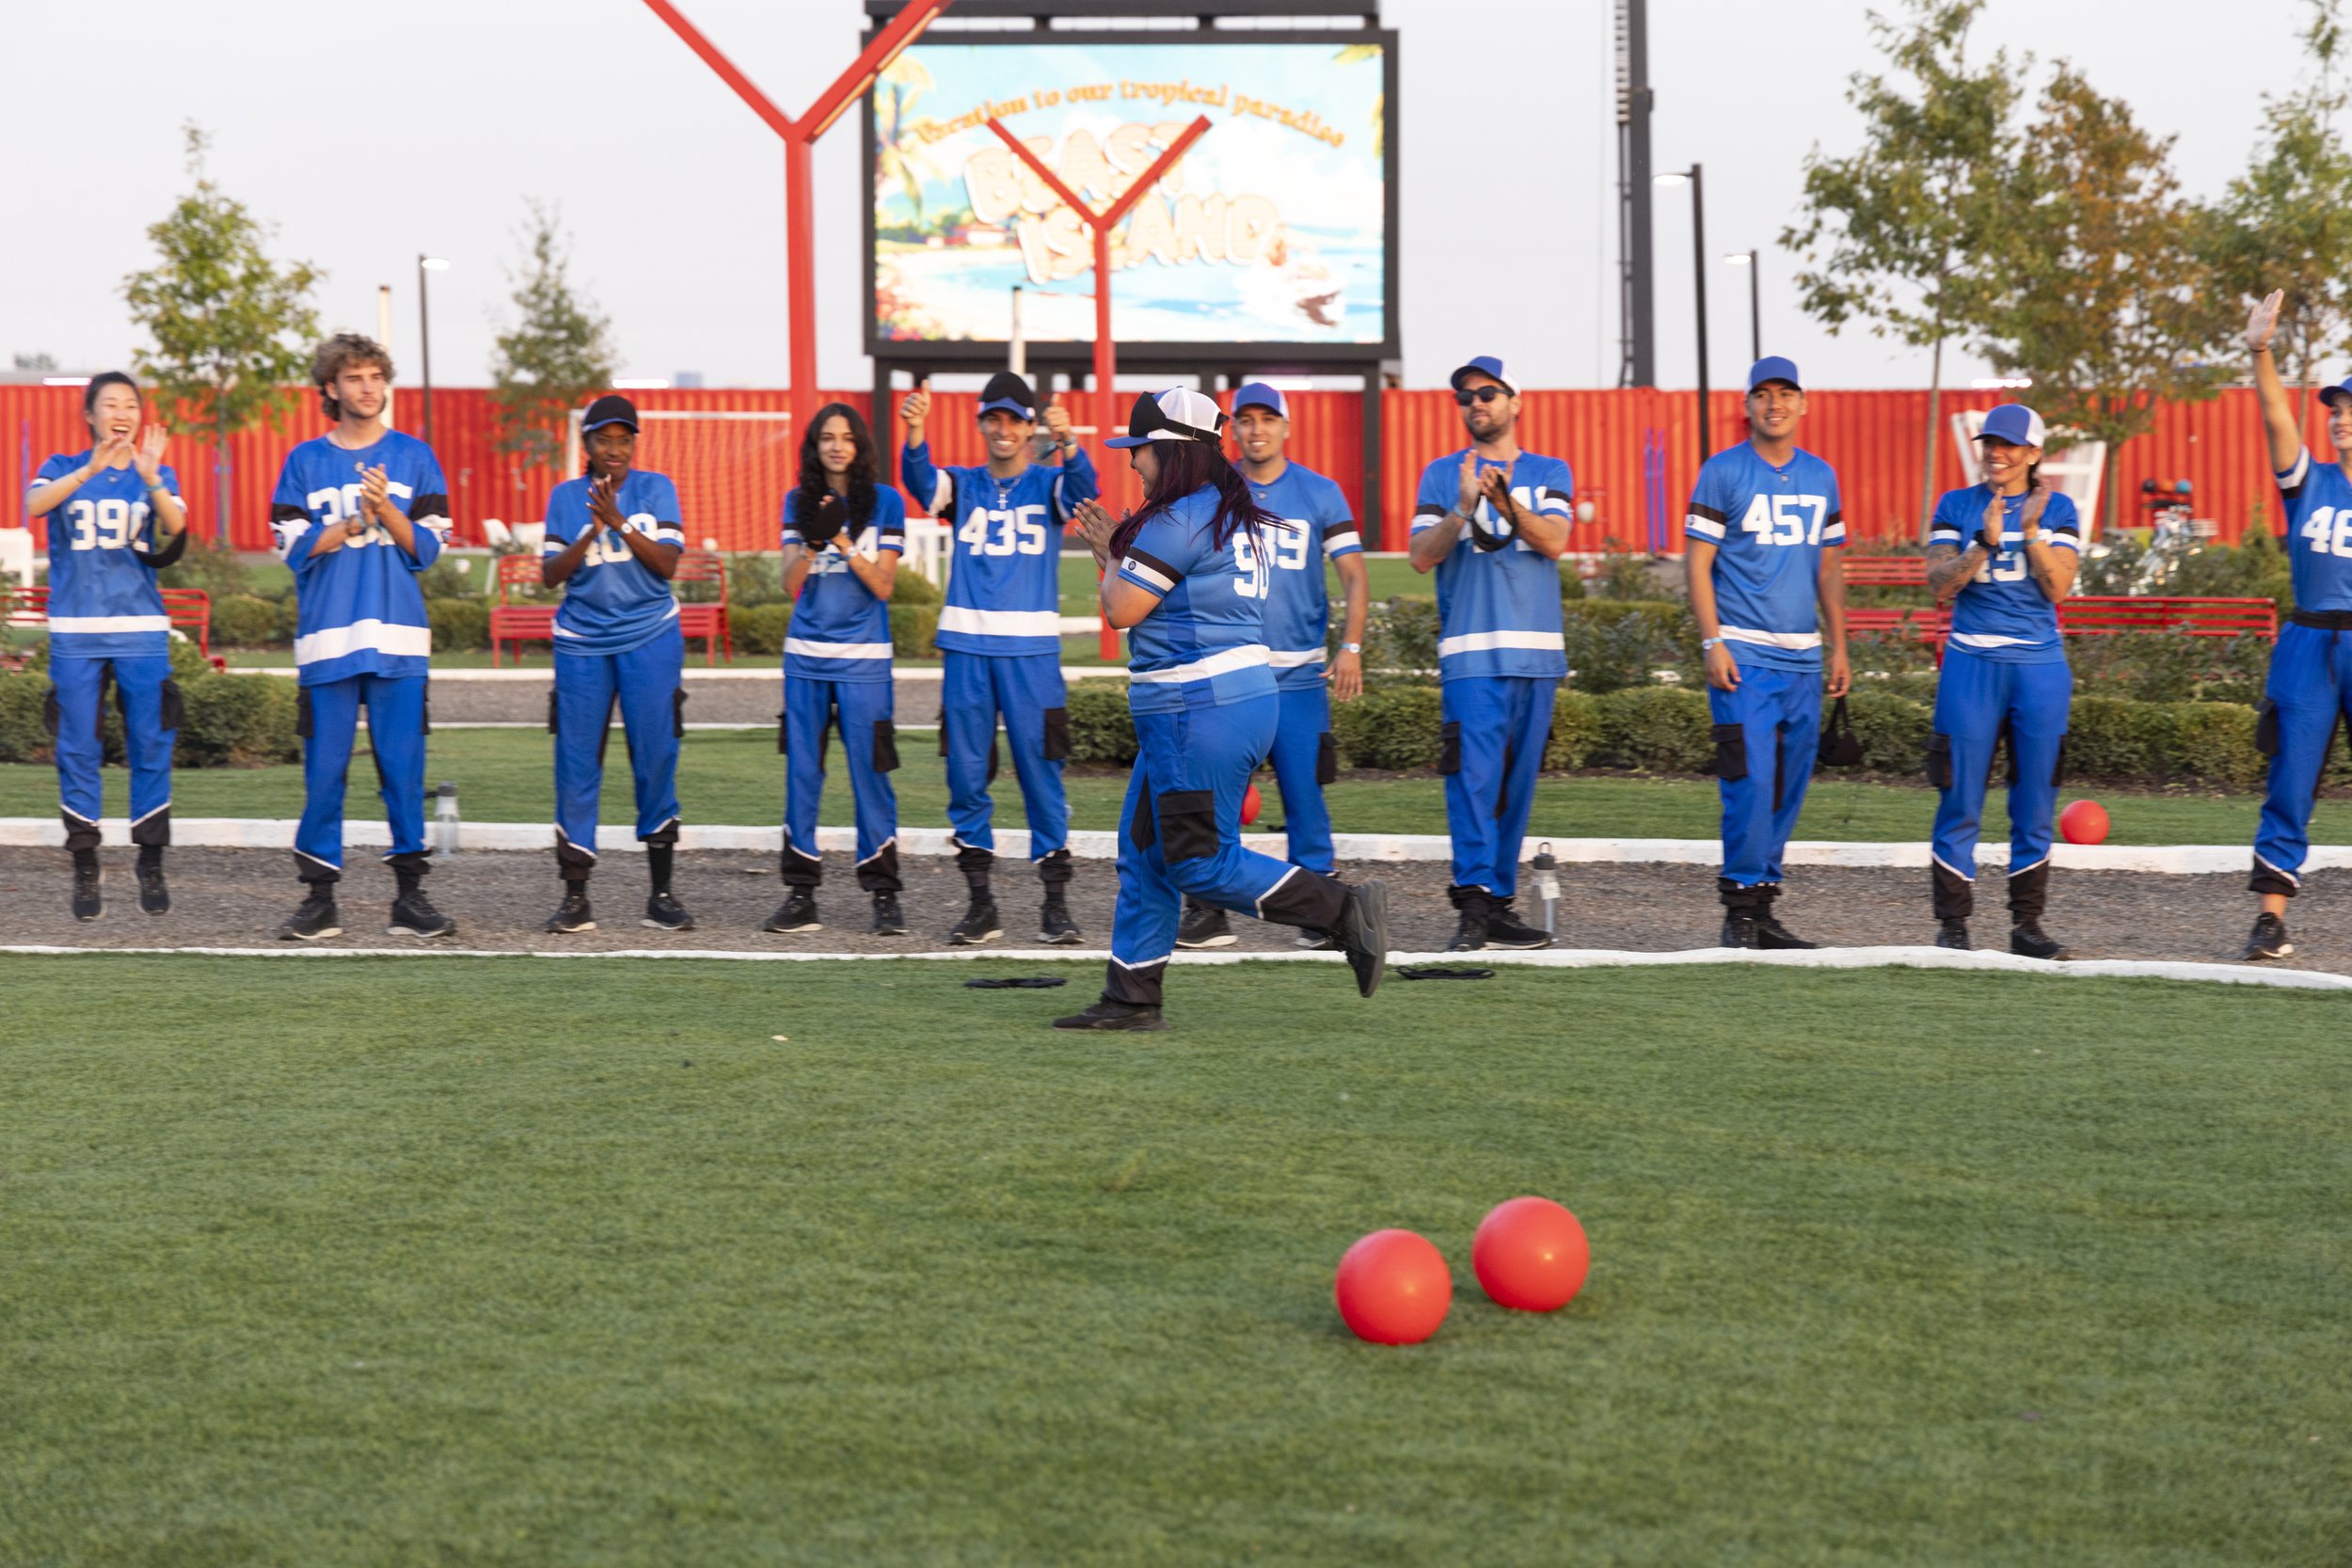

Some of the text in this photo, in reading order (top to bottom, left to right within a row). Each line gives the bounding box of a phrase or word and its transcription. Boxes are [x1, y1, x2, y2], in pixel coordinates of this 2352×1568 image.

[1032, 88, 1062, 109] to
[1065, 82, 1115, 103] our
[1119, 78, 1230, 107] tropical
[1231, 92, 1346, 150] paradise
[958, 504, 1046, 556] 435
[1741, 493, 1827, 546] 457
